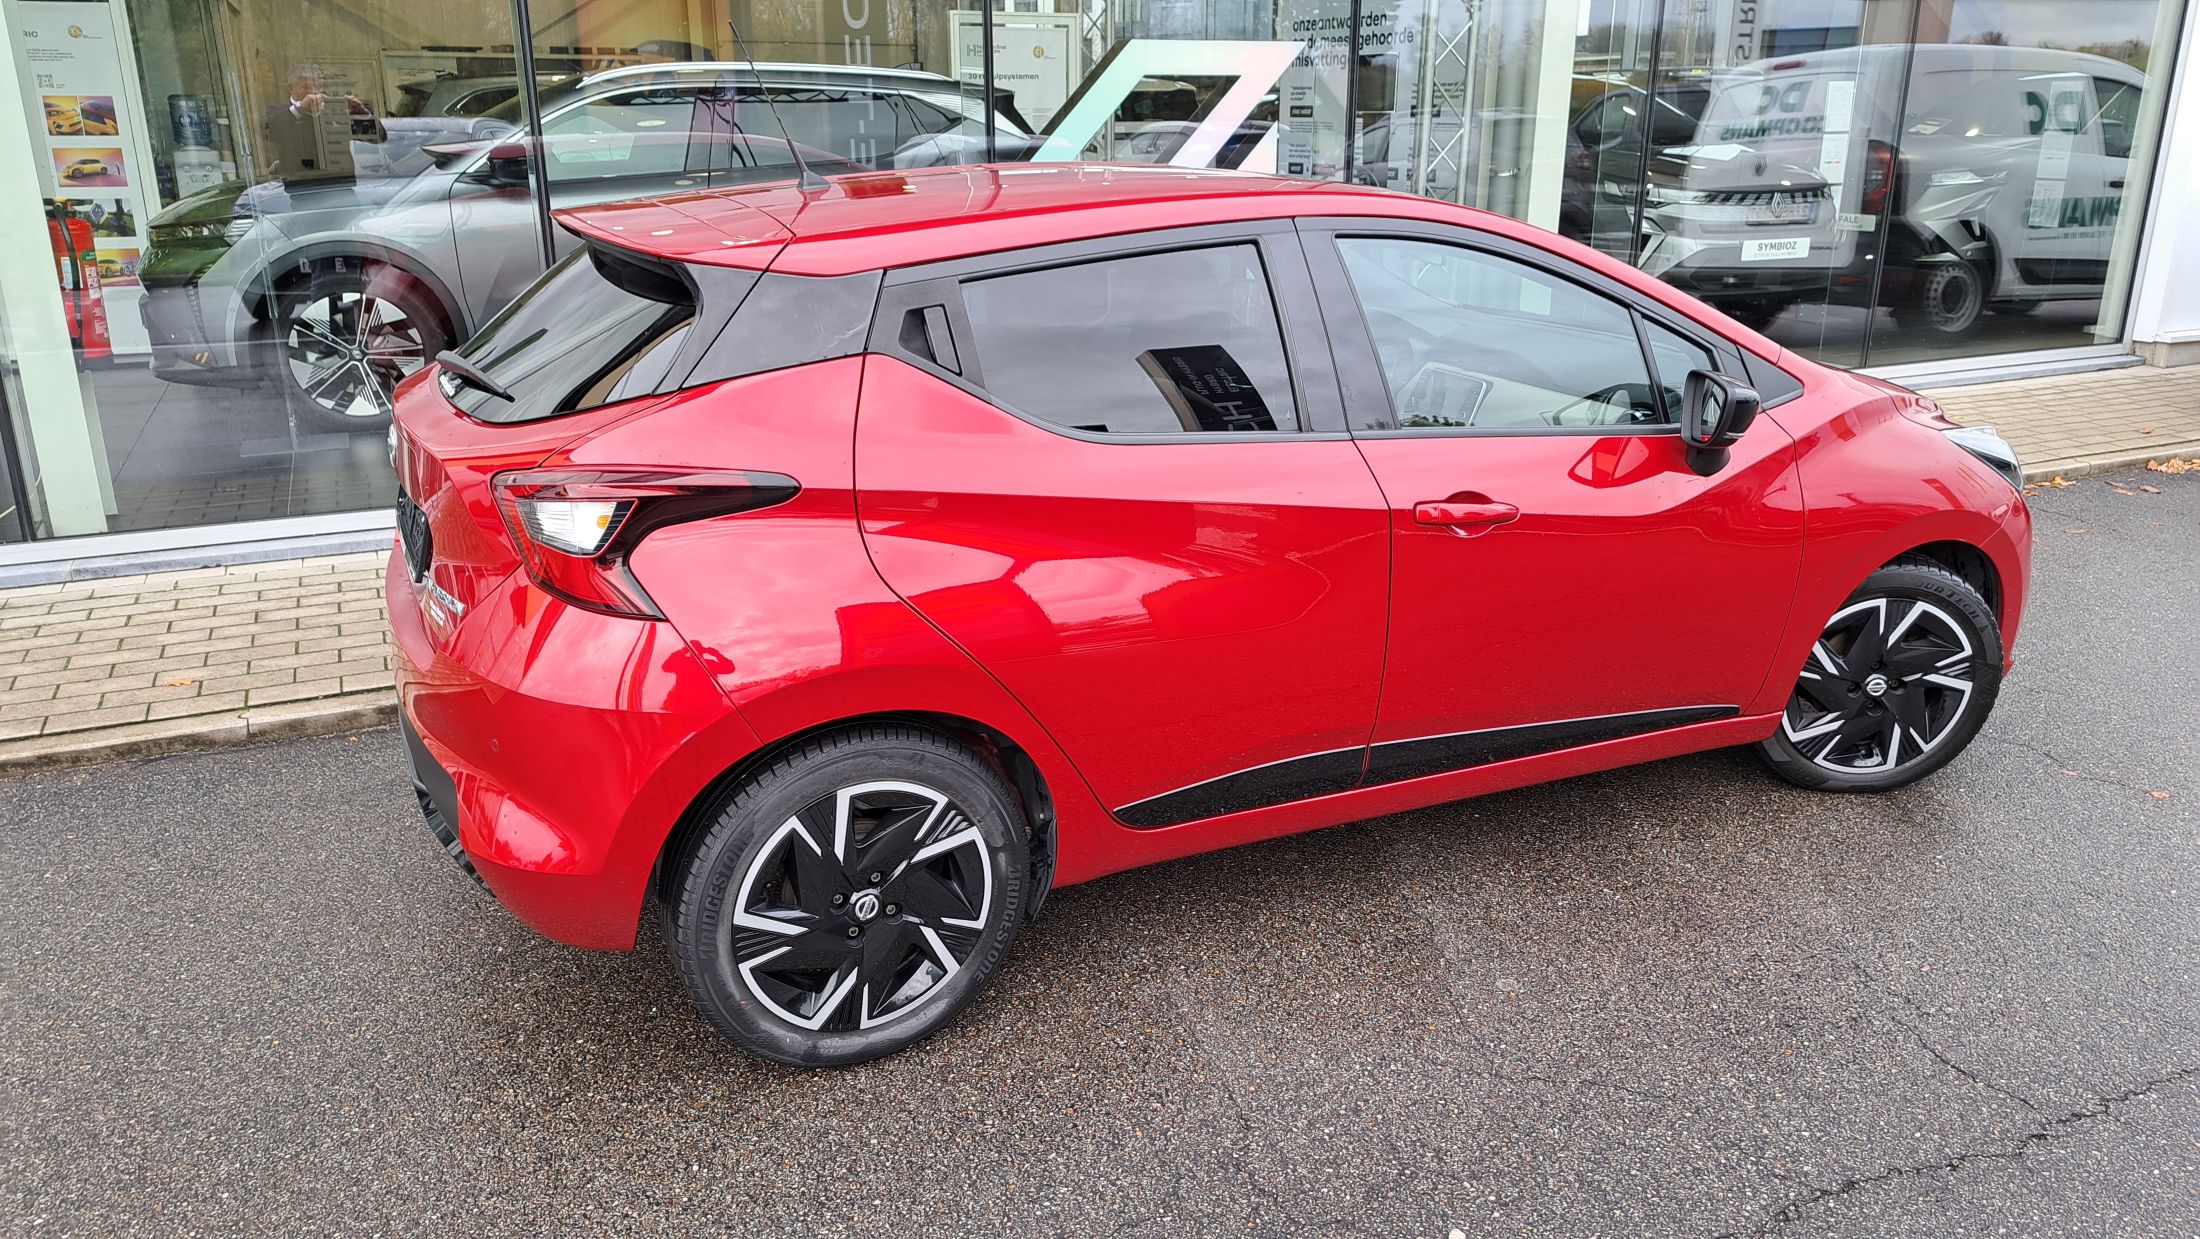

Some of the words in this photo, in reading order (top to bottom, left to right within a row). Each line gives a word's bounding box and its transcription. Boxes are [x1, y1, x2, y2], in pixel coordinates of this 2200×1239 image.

[1293, 18, 1316, 32] onze
[1317, 11, 1387, 30] antworden
[1321, 37, 1350, 48] mees
[1359, 27, 1414, 50] gehoorde
[1292, 52, 1348, 70] misvatting
[1758, 241, 1798, 251] SYMBIOZ
[974, 863, 1022, 984] BRIDGESTONE
